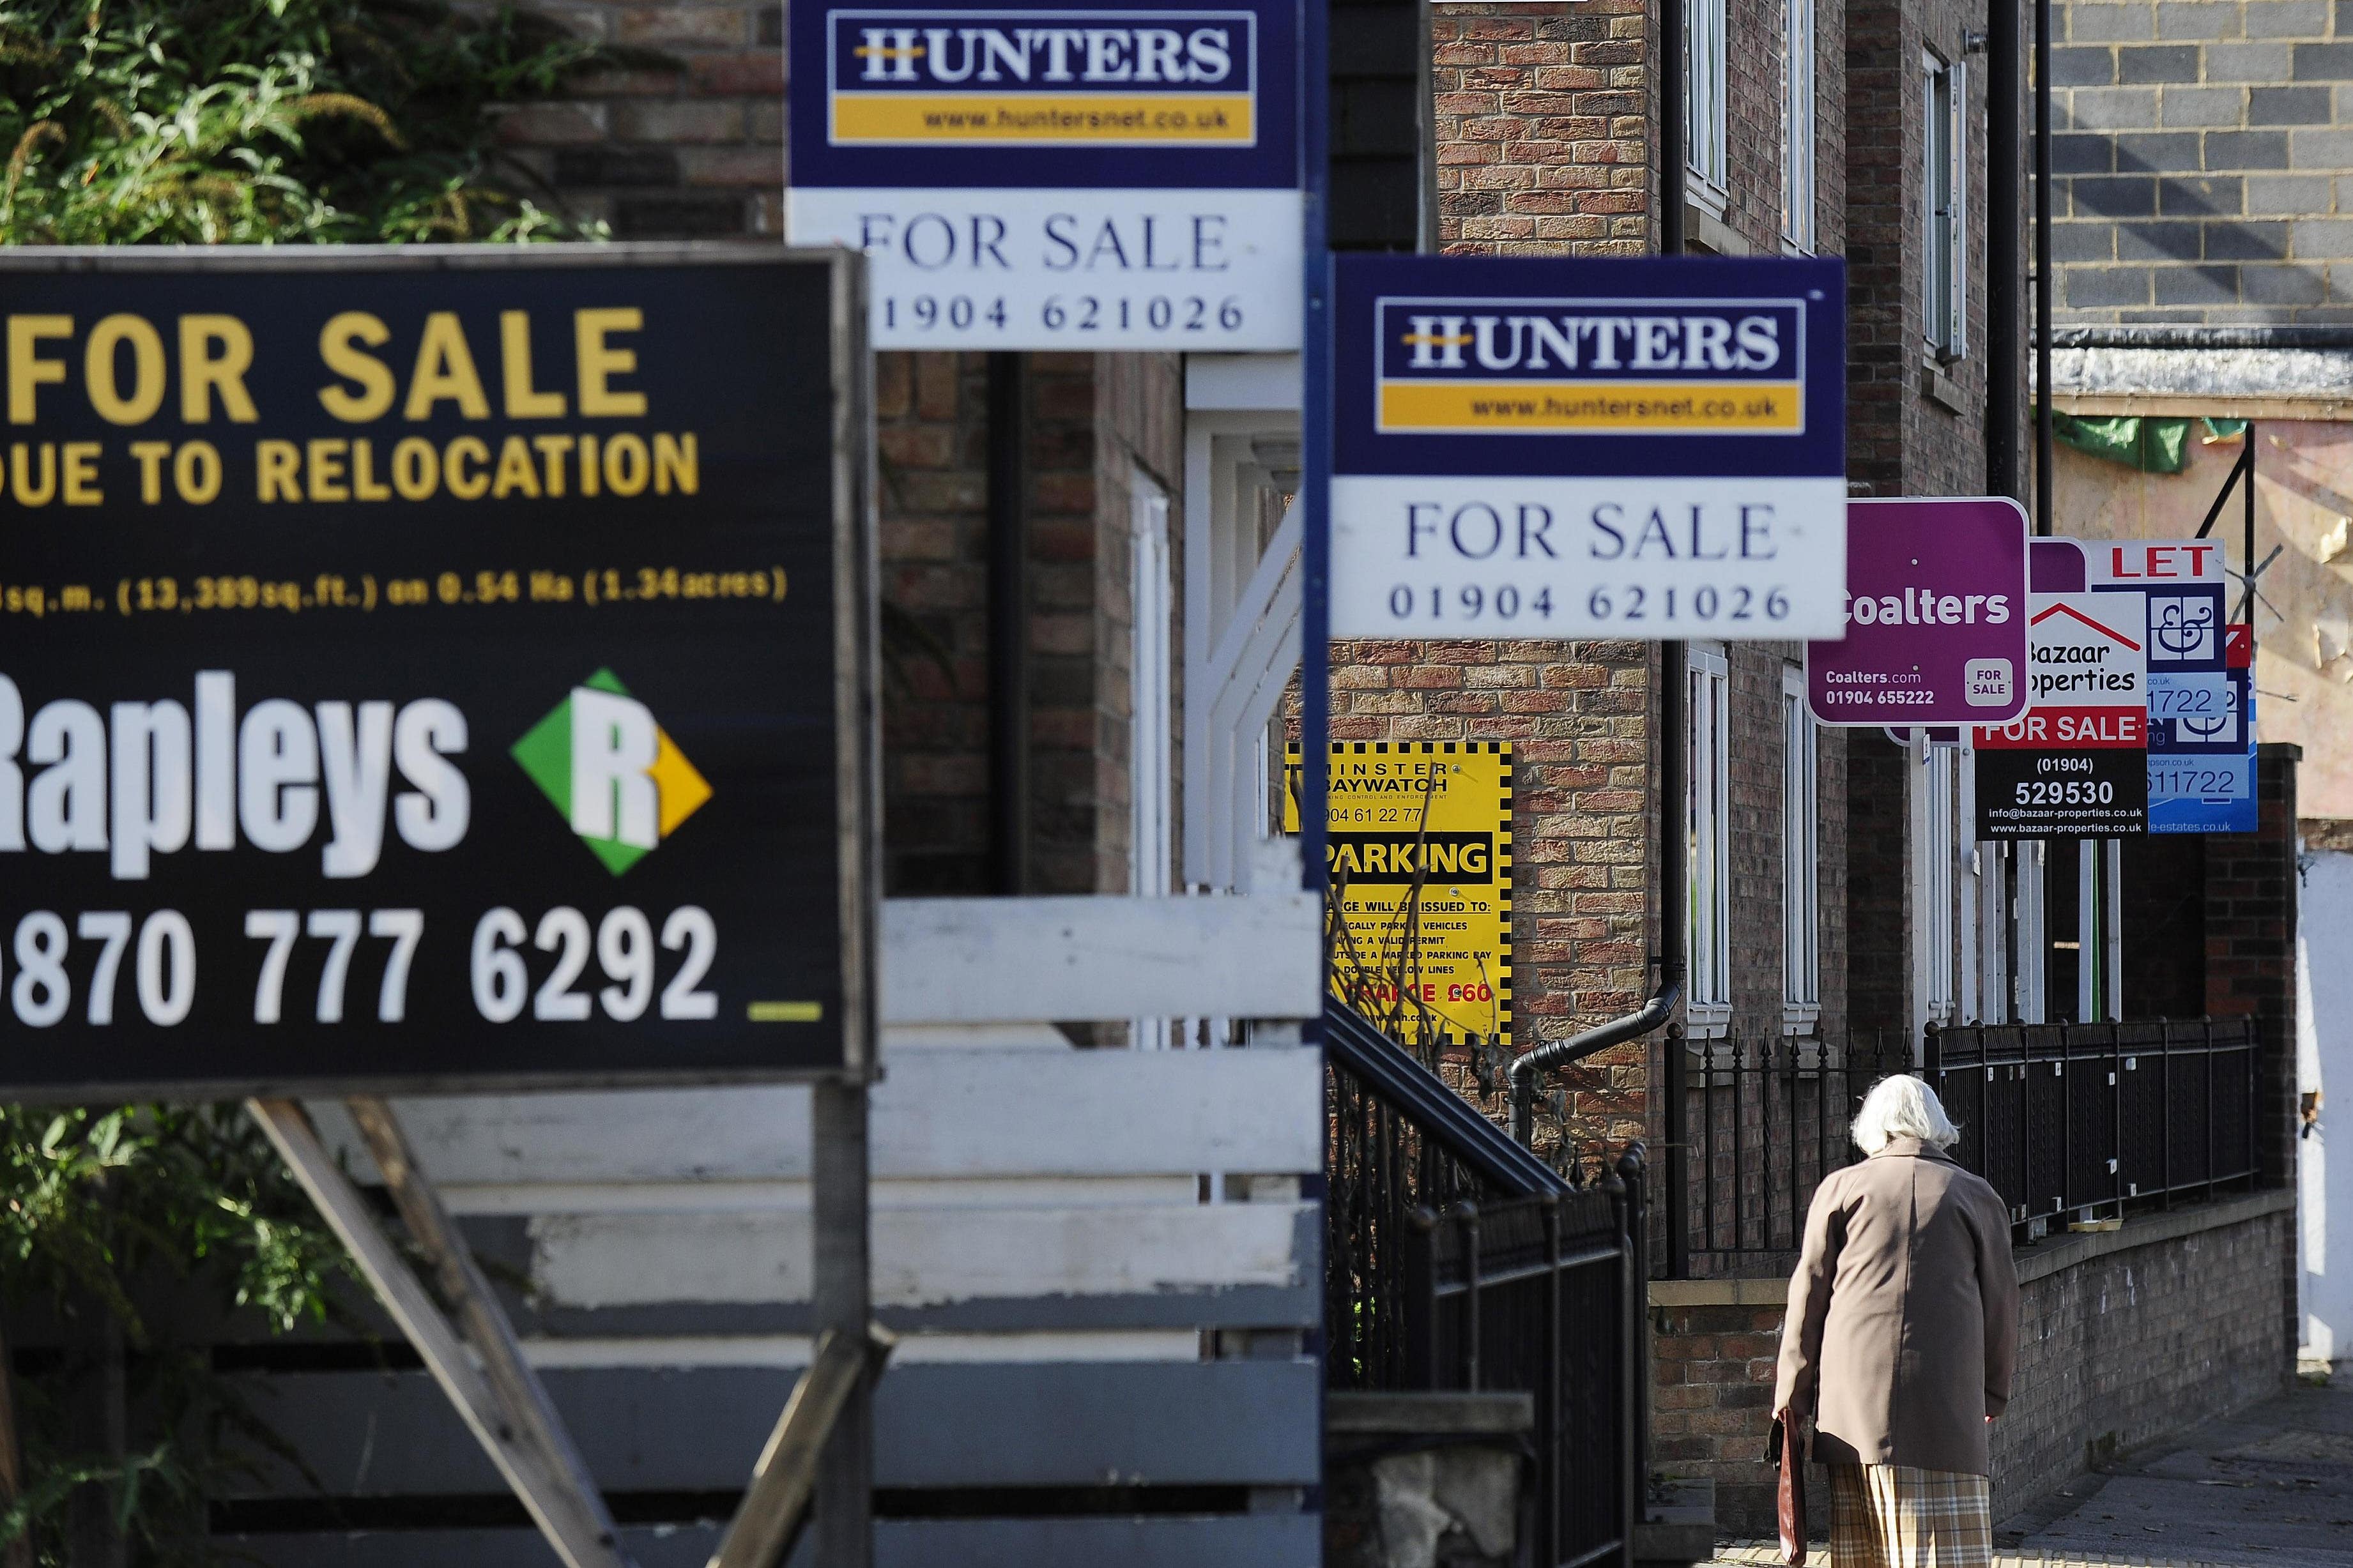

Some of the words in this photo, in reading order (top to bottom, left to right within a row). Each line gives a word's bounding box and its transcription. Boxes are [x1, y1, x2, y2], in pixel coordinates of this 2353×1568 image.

[854, 27, 1231, 83] HUNTERS
[923, 107, 1229, 130] www.huntersnet.co.uk
[857, 212, 1013, 271] FOR
[1041, 212, 1230, 271] SALE
[884, 294, 1009, 331] 1904
[1041, 294, 1245, 331] 621026
[1401, 315, 1781, 370] HUNTERS
[6, 312, 259, 426] FOR
[317, 307, 648, 423] SALE
[1471, 395, 1778, 419] www.huntersnet.co.uk
[0, 441, 104, 507] UE
[129, 440, 224, 505] TO
[257, 431, 699, 503] RELOCATION
[1403, 501, 1562, 561] FOR
[1588, 502, 1778, 561] SALE
[2112, 546, 2214, 578] LET
[0, 584, 105, 618] sq.m.
[437, 570, 521, 604] 0.54
[1388, 584, 1555, 620] 01904
[1588, 584, 1791, 621] 621026
[1825, 671, 1922, 684] Coalters.com
[1977, 670, 2002, 681] FOR
[2031, 668, 2136, 699] perties
[2147, 677, 2170, 685] co.uk
[1825, 690, 1873, 704] 01904
[1876, 690, 1935, 704] 655222
[1972, 684, 2006, 695] SALE
[2147, 690, 2212, 713] 1722
[1985, 716, 2048, 741] FOR
[2057, 716, 2136, 741] SALE
[2037, 758, 2094, 775] (01904)
[2147, 758, 2195, 767] pson.co.uk
[2015, 781, 2113, 805] 529530
[1325, 808, 1349, 823] 04
[1354, 808, 1372, 823] 61
[1378, 808, 1398, 823] 22
[1403, 807, 1422, 823] 77
[1989, 809, 2143, 820] info@bazaar-properties.co.uk
[1990, 824, 2142, 834] www.bazaar-properties.co.uk
[2148, 821, 2231, 832] e-estates.co.uk
[1365, 901, 1394, 912] WILL
[1421, 901, 1465, 912] ISSUED
[1470, 901, 1491, 912] TO:
[1423, 922, 1468, 930] VEHICLES
[1367, 936, 1374, 945] A
[0, 908, 197, 1028] 870
[244, 908, 424, 1024] 777
[470, 905, 718, 1023] 6292
[1370, 951, 1377, 959] A
[1427, 951, 1469, 959] PARKING
[1473, 951, 1492, 959] BAY
[1428, 966, 1454, 974] LINES
